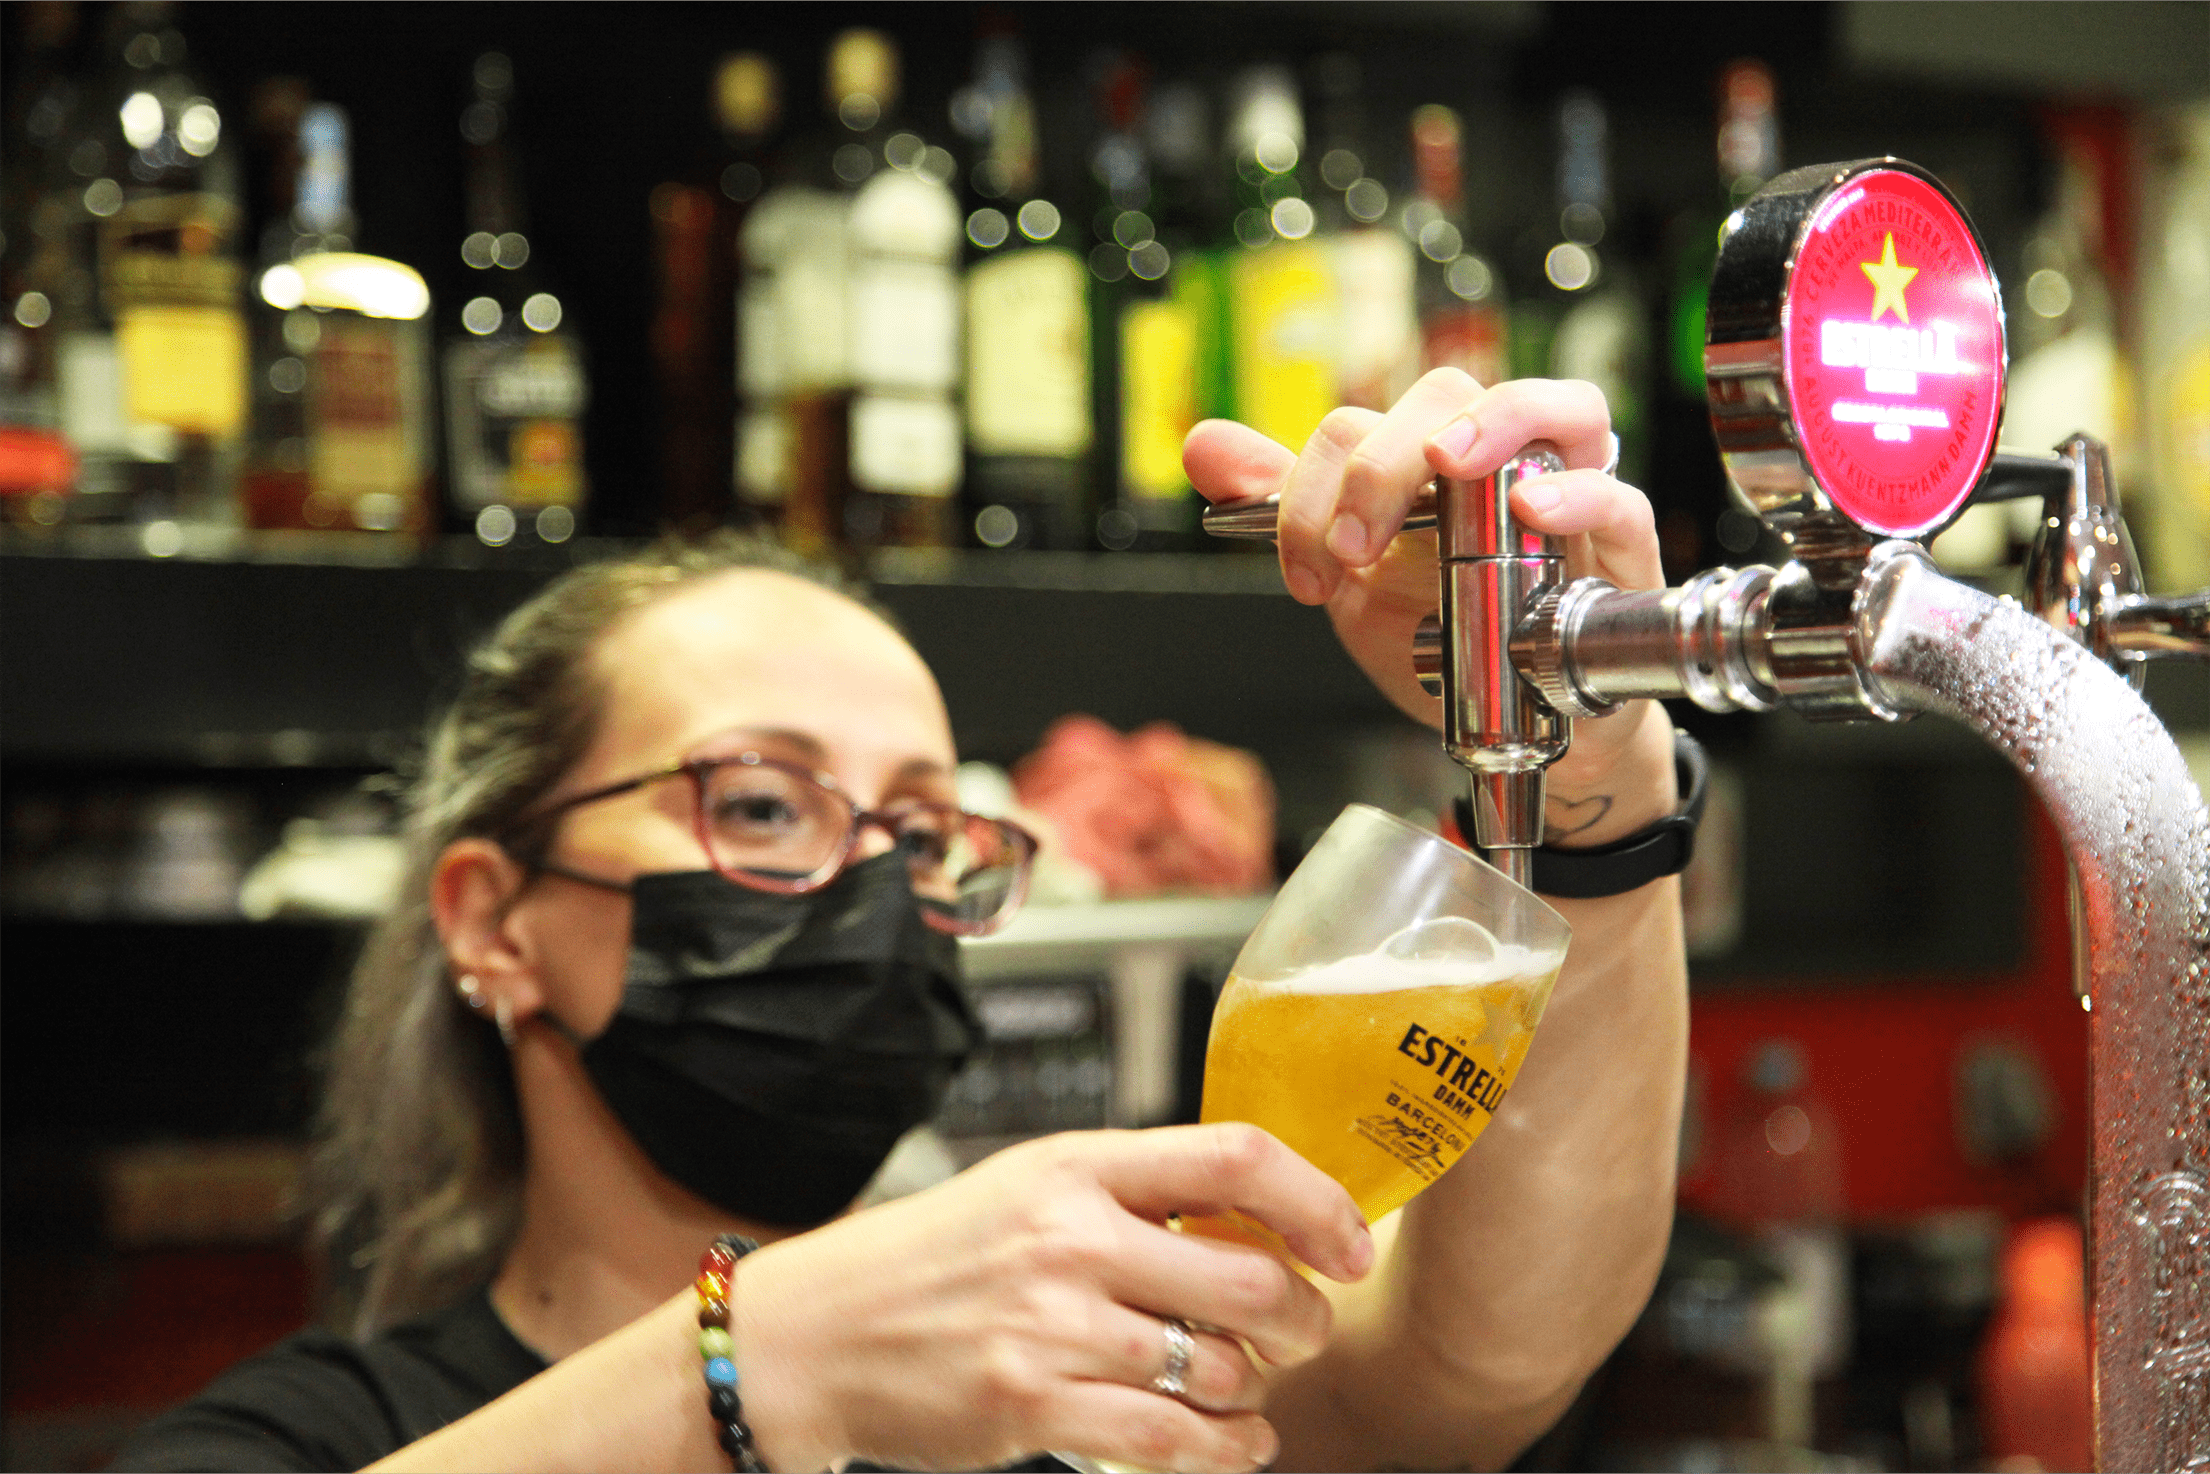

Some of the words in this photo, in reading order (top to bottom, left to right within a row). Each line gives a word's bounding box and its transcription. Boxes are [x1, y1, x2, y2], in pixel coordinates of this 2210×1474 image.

[1806, 209, 1862, 300] CERVEZA
[1804, 376, 1848, 467] AUGUST
[1846, 453, 1951, 504] KUENTZMANN
[1947, 390, 1978, 461] DAMM
[1385, 1091, 1466, 1153] BARCELON
[1432, 1083, 1476, 1121] DAMM
